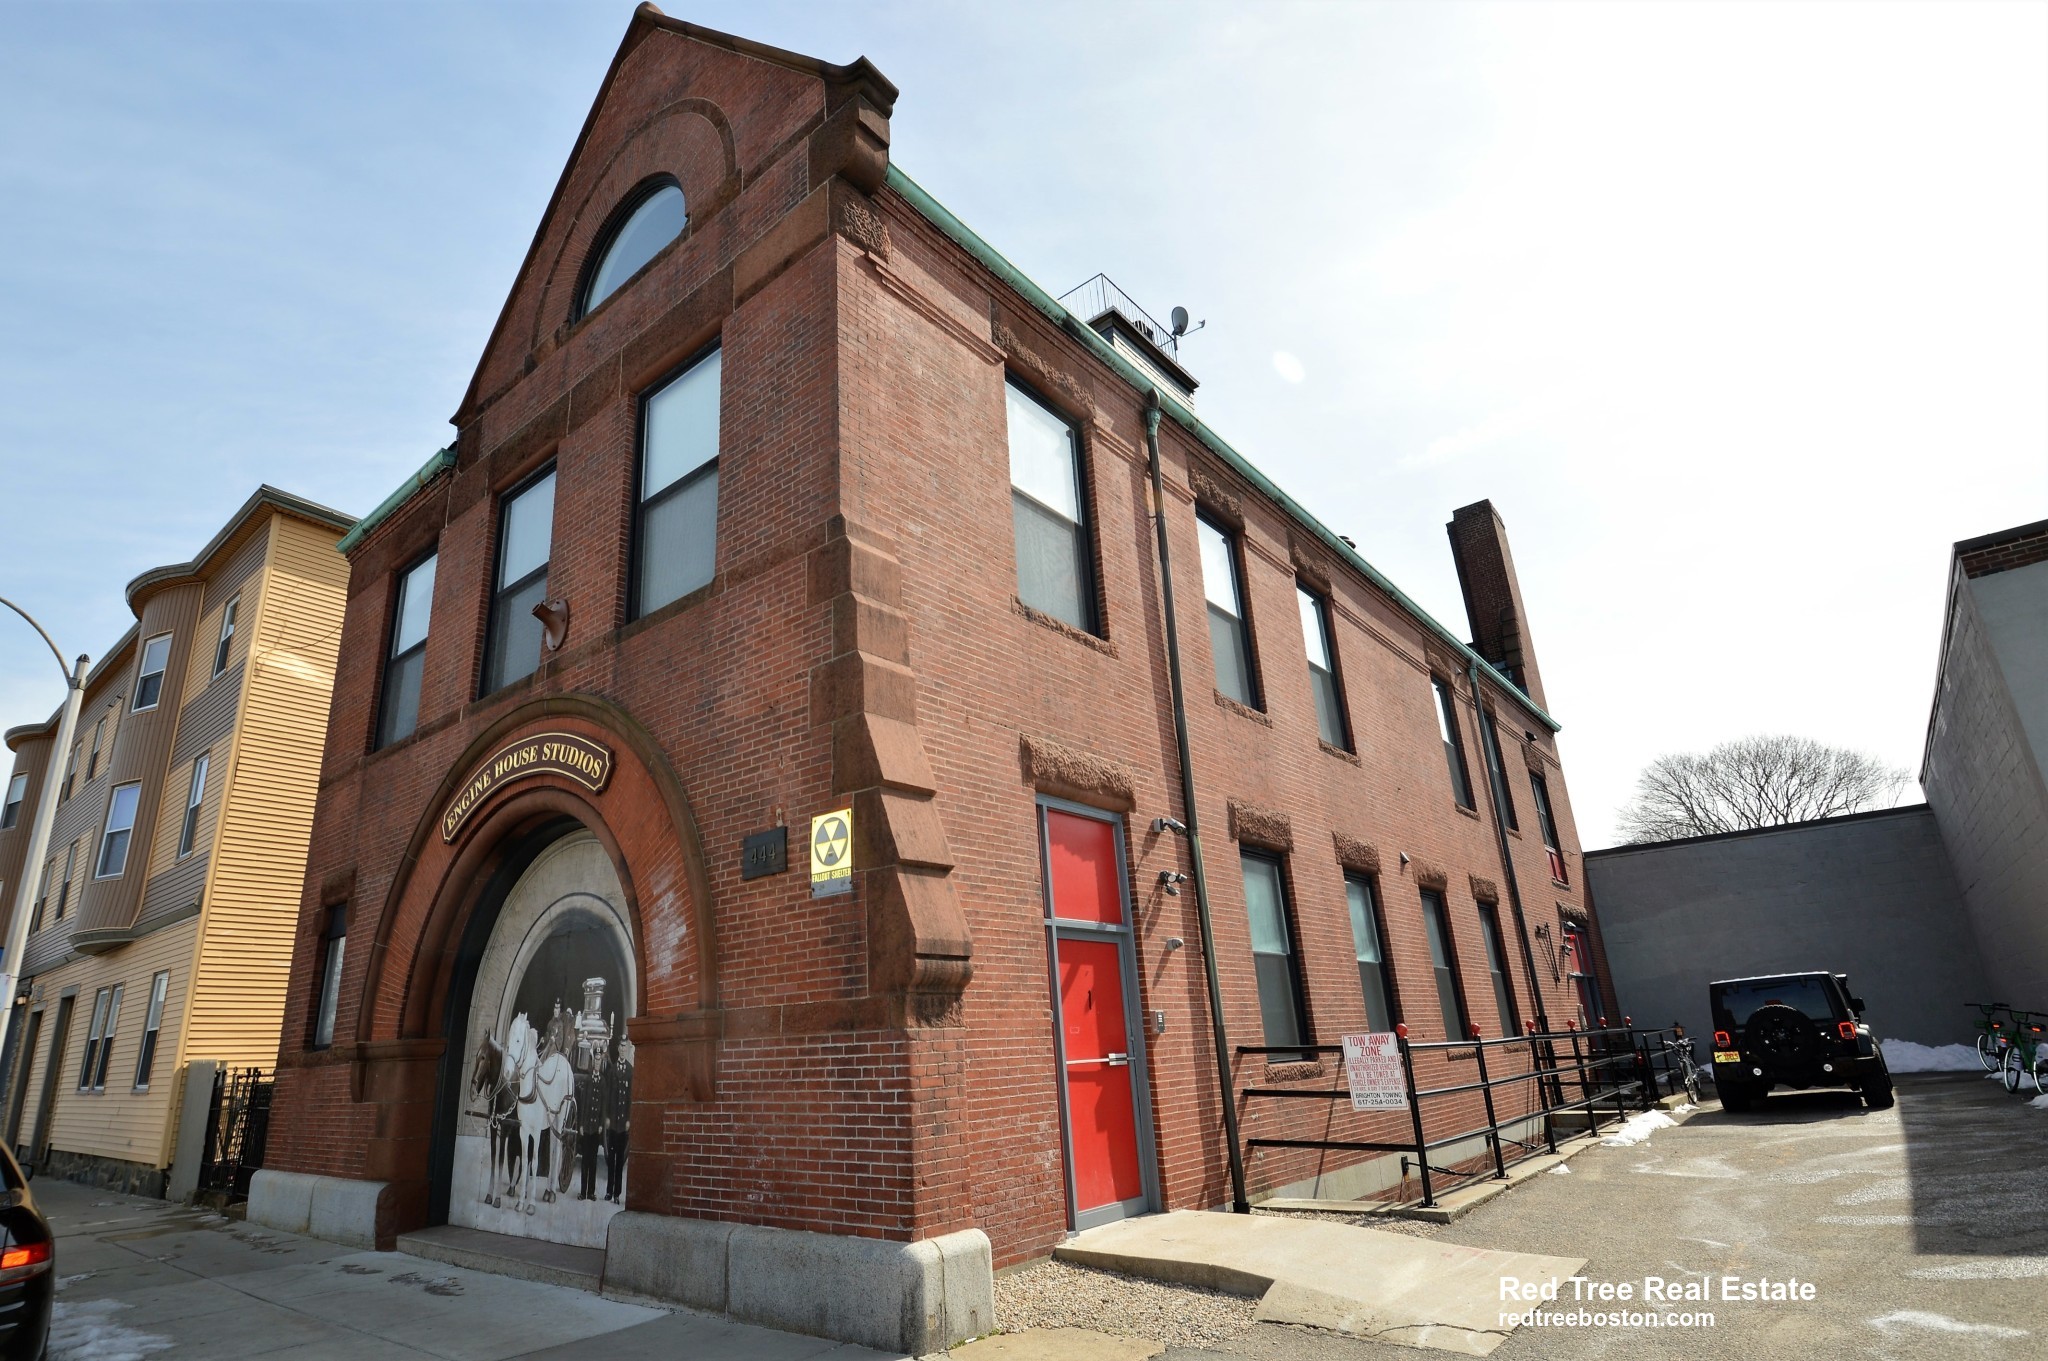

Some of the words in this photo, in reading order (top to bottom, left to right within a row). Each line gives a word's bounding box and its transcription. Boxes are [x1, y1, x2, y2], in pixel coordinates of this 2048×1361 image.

[446, 770, 491, 831] ENGINE
[494, 745, 538, 779] HOUSE
[542, 742, 602, 779] STUDIOS
[751, 843, 775, 864] 444
[812, 871, 830, 883] FALLOUT
[831, 867, 851, 879] SHELTER
[1348, 1037, 1366, 1047] TOW
[1369, 1035, 1390, 1046] AWAY
[1360, 1046, 1381, 1057] ZONE
[1370, 1056, 1387, 1064] PARKED
